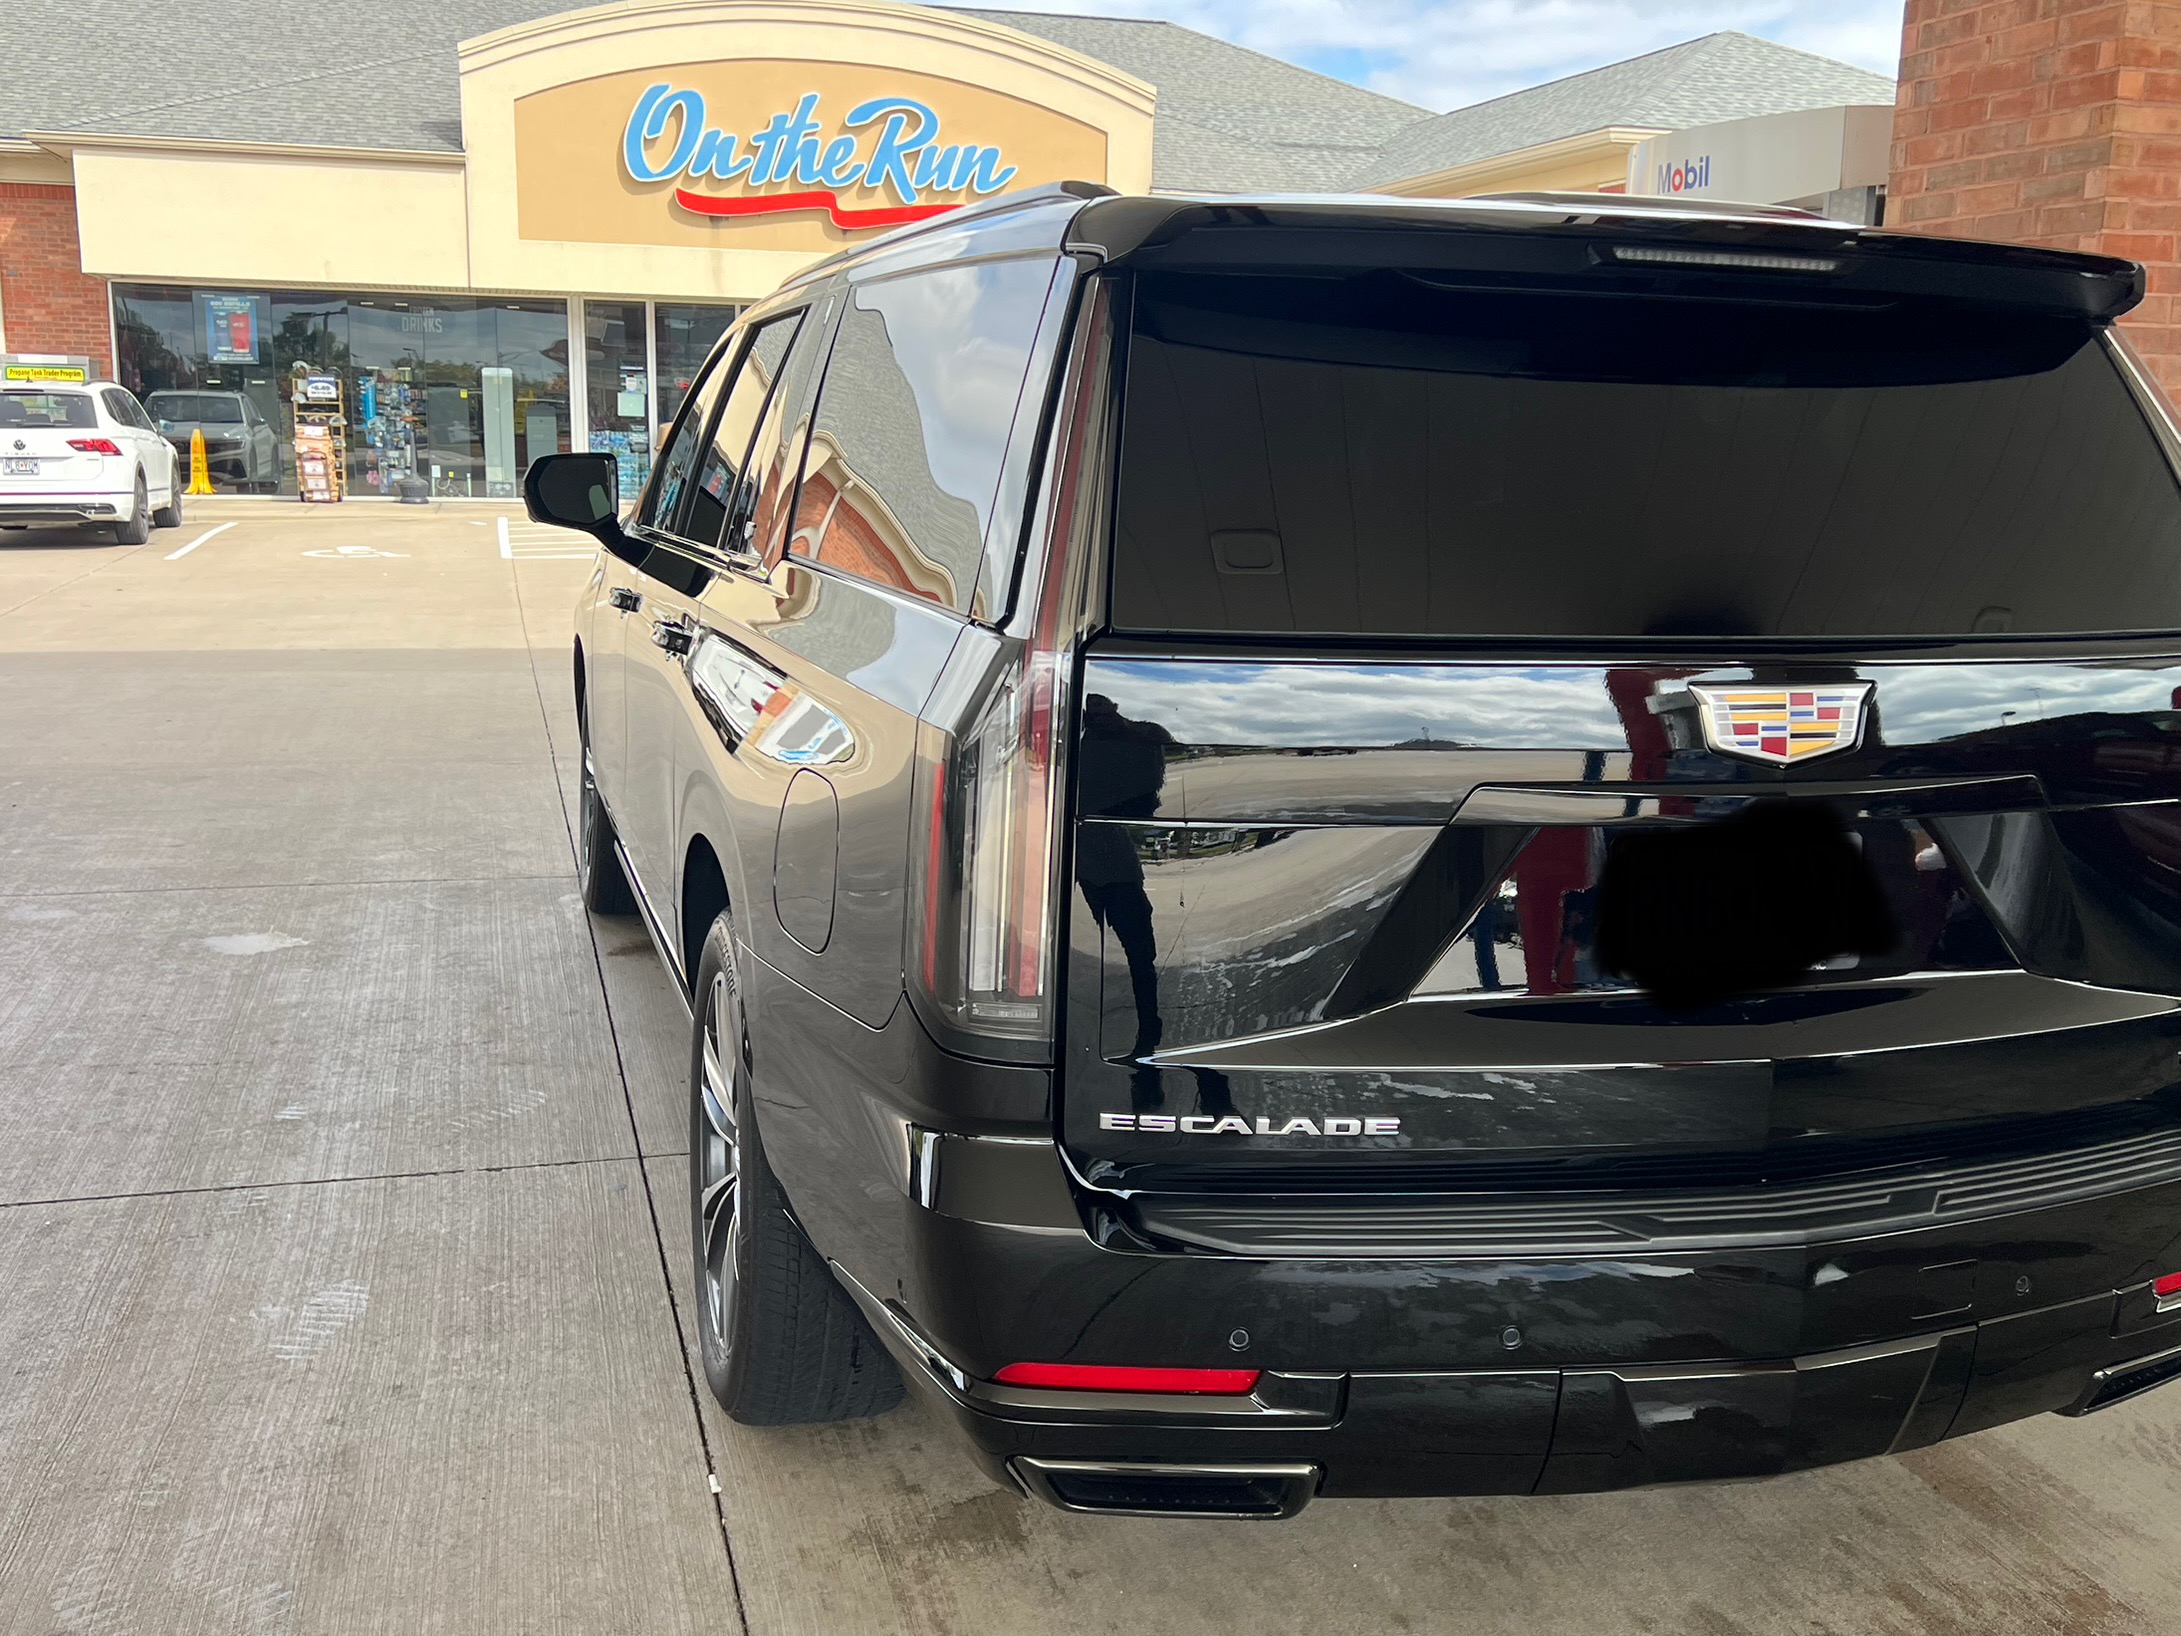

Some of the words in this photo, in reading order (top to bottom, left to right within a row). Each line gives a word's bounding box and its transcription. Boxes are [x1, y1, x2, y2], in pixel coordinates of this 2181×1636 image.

[623, 83, 752, 182] On
[749, 93, 865, 188] the
[845, 97, 1018, 205] Run
[1657, 155, 1710, 195] Mobil
[401, 316, 442, 333] DRINKS
[9, 368, 30, 377] Propane
[31, 368, 42, 376] Tank
[43, 369, 59, 377] Trader
[60, 369, 81, 378] Program
[1099, 1112, 1401, 1136] ESCALADE
